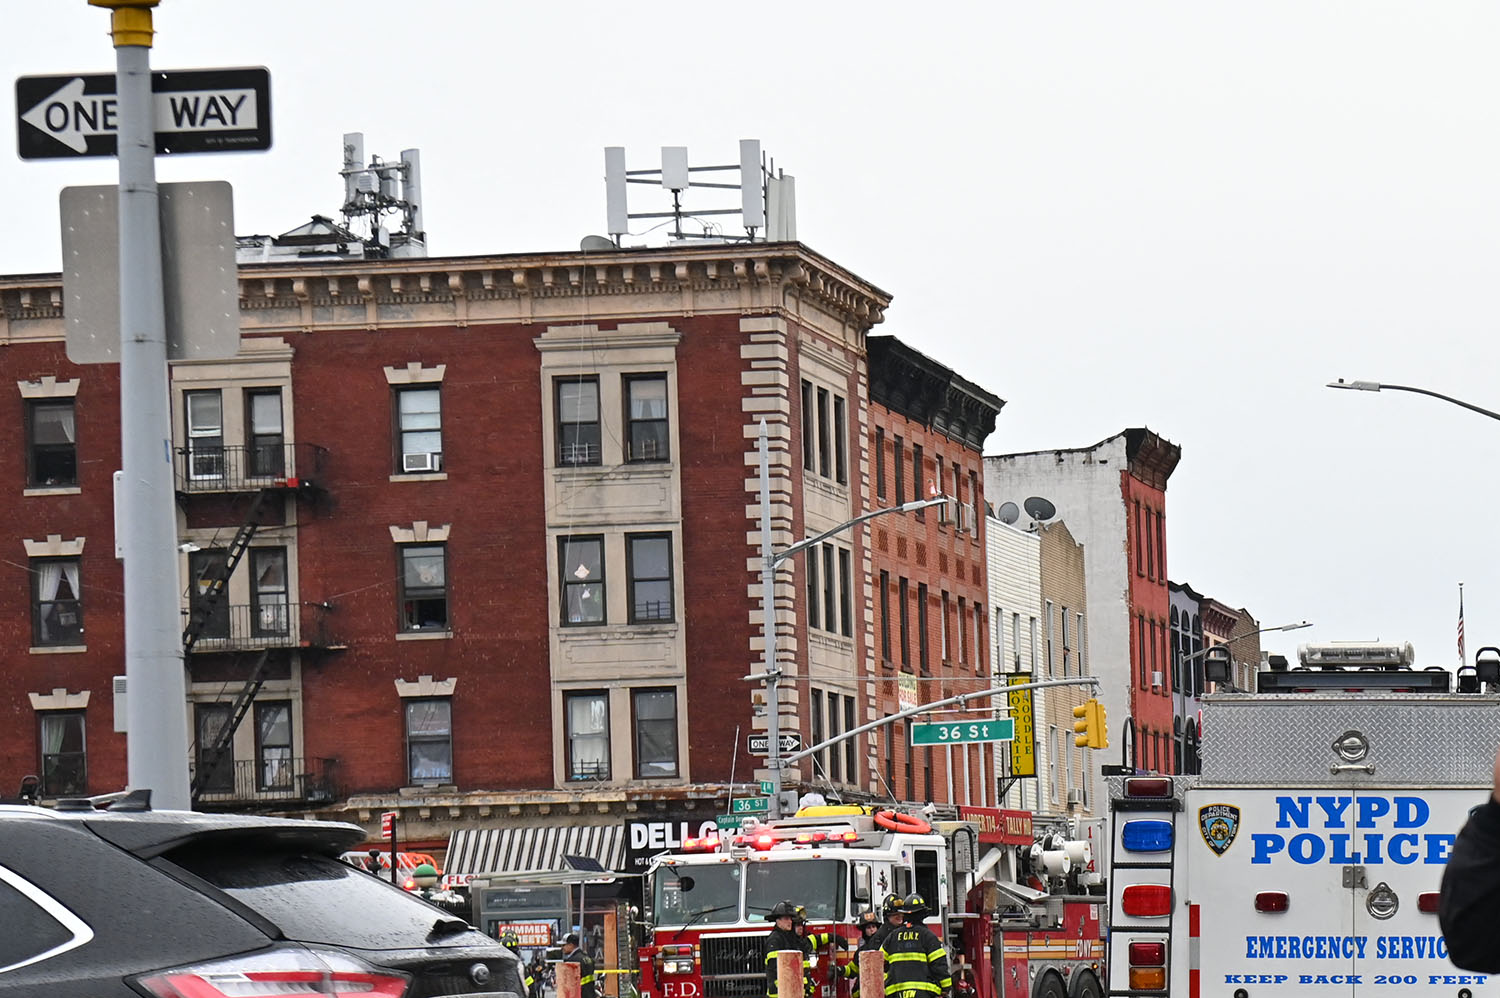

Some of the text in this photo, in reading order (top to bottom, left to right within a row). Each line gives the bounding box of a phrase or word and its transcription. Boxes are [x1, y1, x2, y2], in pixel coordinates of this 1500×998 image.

[45, 95, 247, 132] ONE WAY
[938, 724, 989, 740] 36 St
[753, 740, 768, 748] ONE
[738, 799, 764, 811] 36 ST
[1200, 811, 1238, 821] DEPARTMENT
[1275, 796, 1430, 829] NYPD
[1251, 833, 1457, 865] POLICE
[447, 874, 479, 887] FLO
[501, 924, 548, 934] SUMMER
[1246, 936, 1448, 959] EMERGENCY SERVIC
[1224, 975, 1488, 984] KEEP BACK 200 FEET
[664, 982, 700, 998] F.D.
